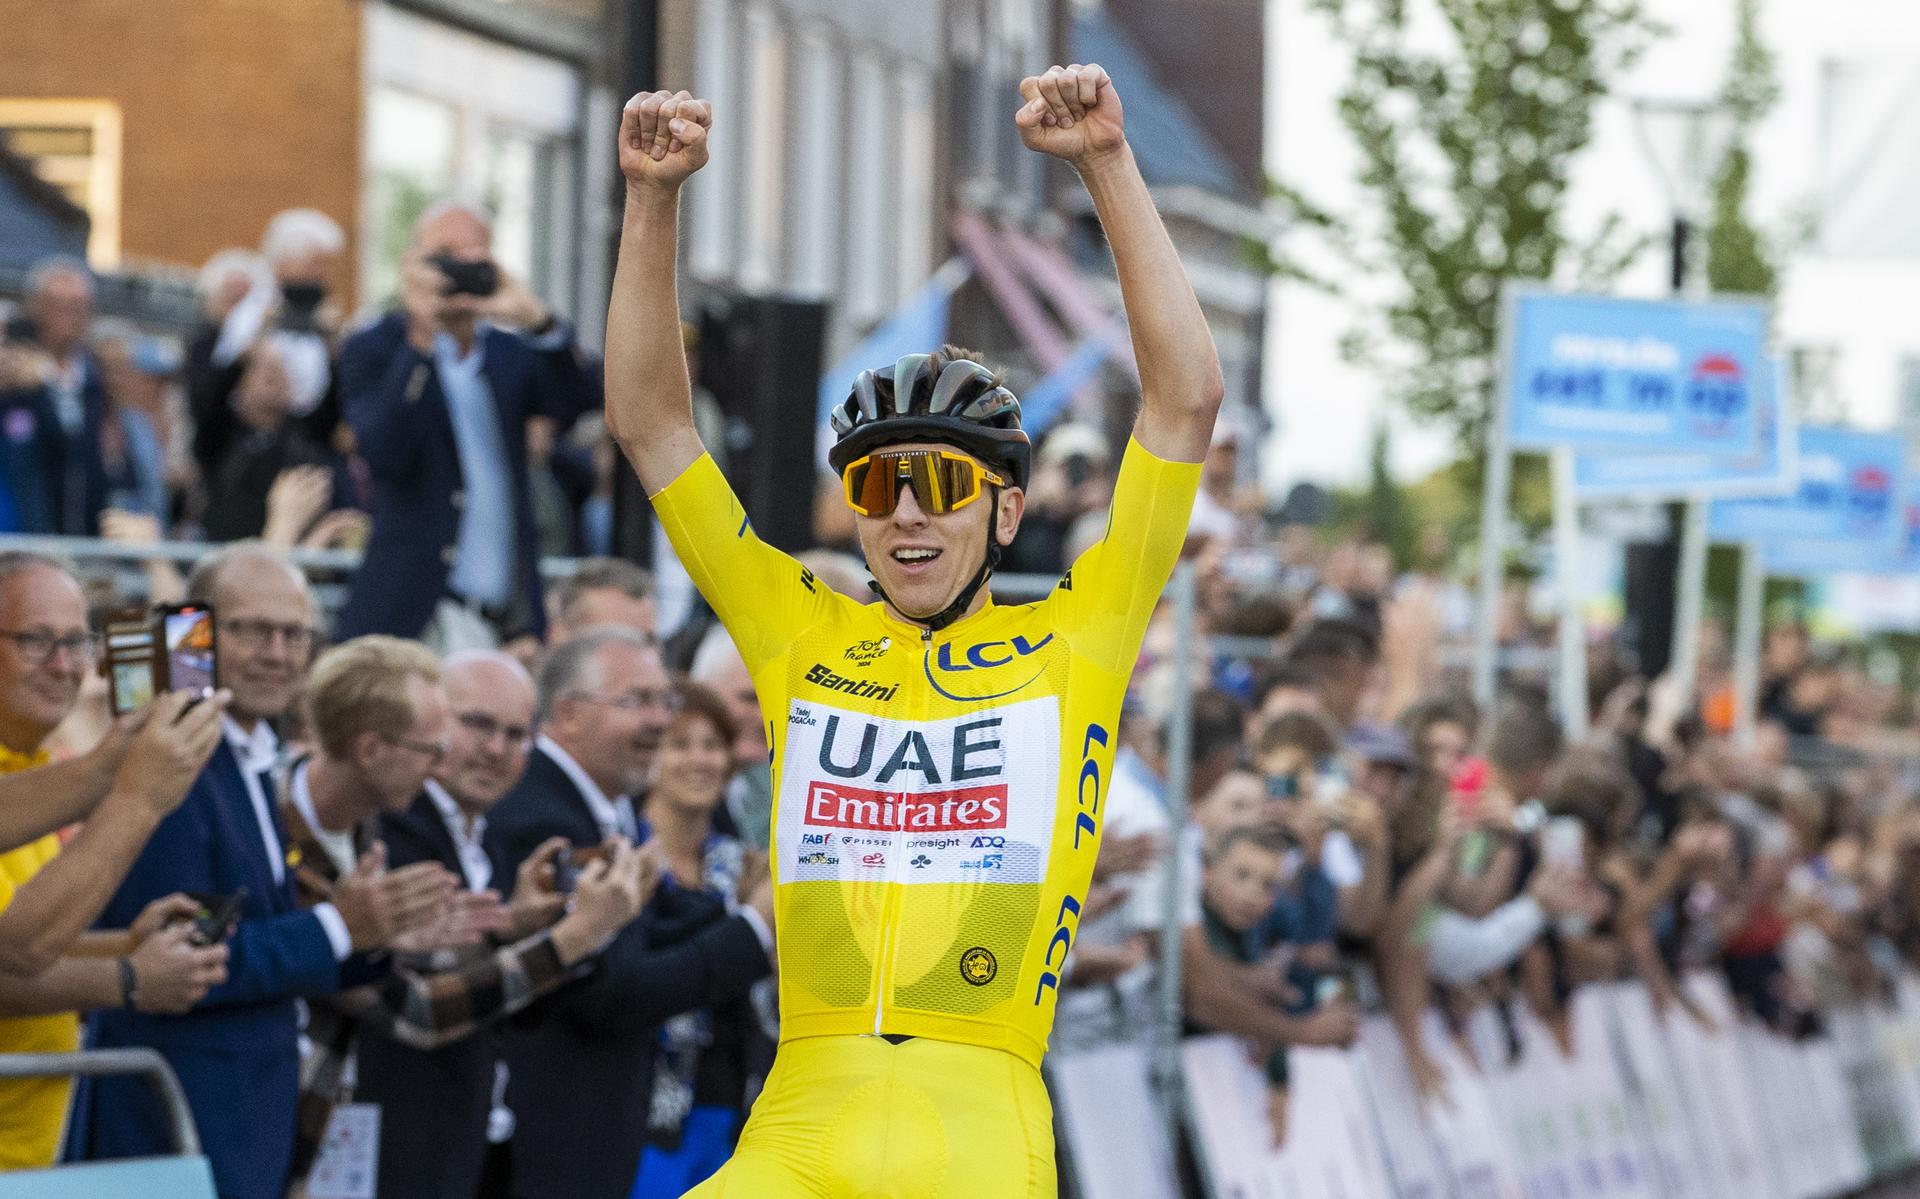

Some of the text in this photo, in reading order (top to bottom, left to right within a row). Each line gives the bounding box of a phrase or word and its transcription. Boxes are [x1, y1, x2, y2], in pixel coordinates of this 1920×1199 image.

[937, 633, 1054, 672] LCL
[803, 663, 900, 702] Santini
[795, 707, 812, 718] Tadej
[818, 715, 1003, 784] UAE
[1074, 723, 1109, 850] LCL
[811, 787, 1002, 830] Emirates
[853, 838, 892, 847] PISSEI
[906, 838, 961, 850] presight
[970, 836, 1006, 848] ADQ
[1034, 894, 1080, 1006] LCL
